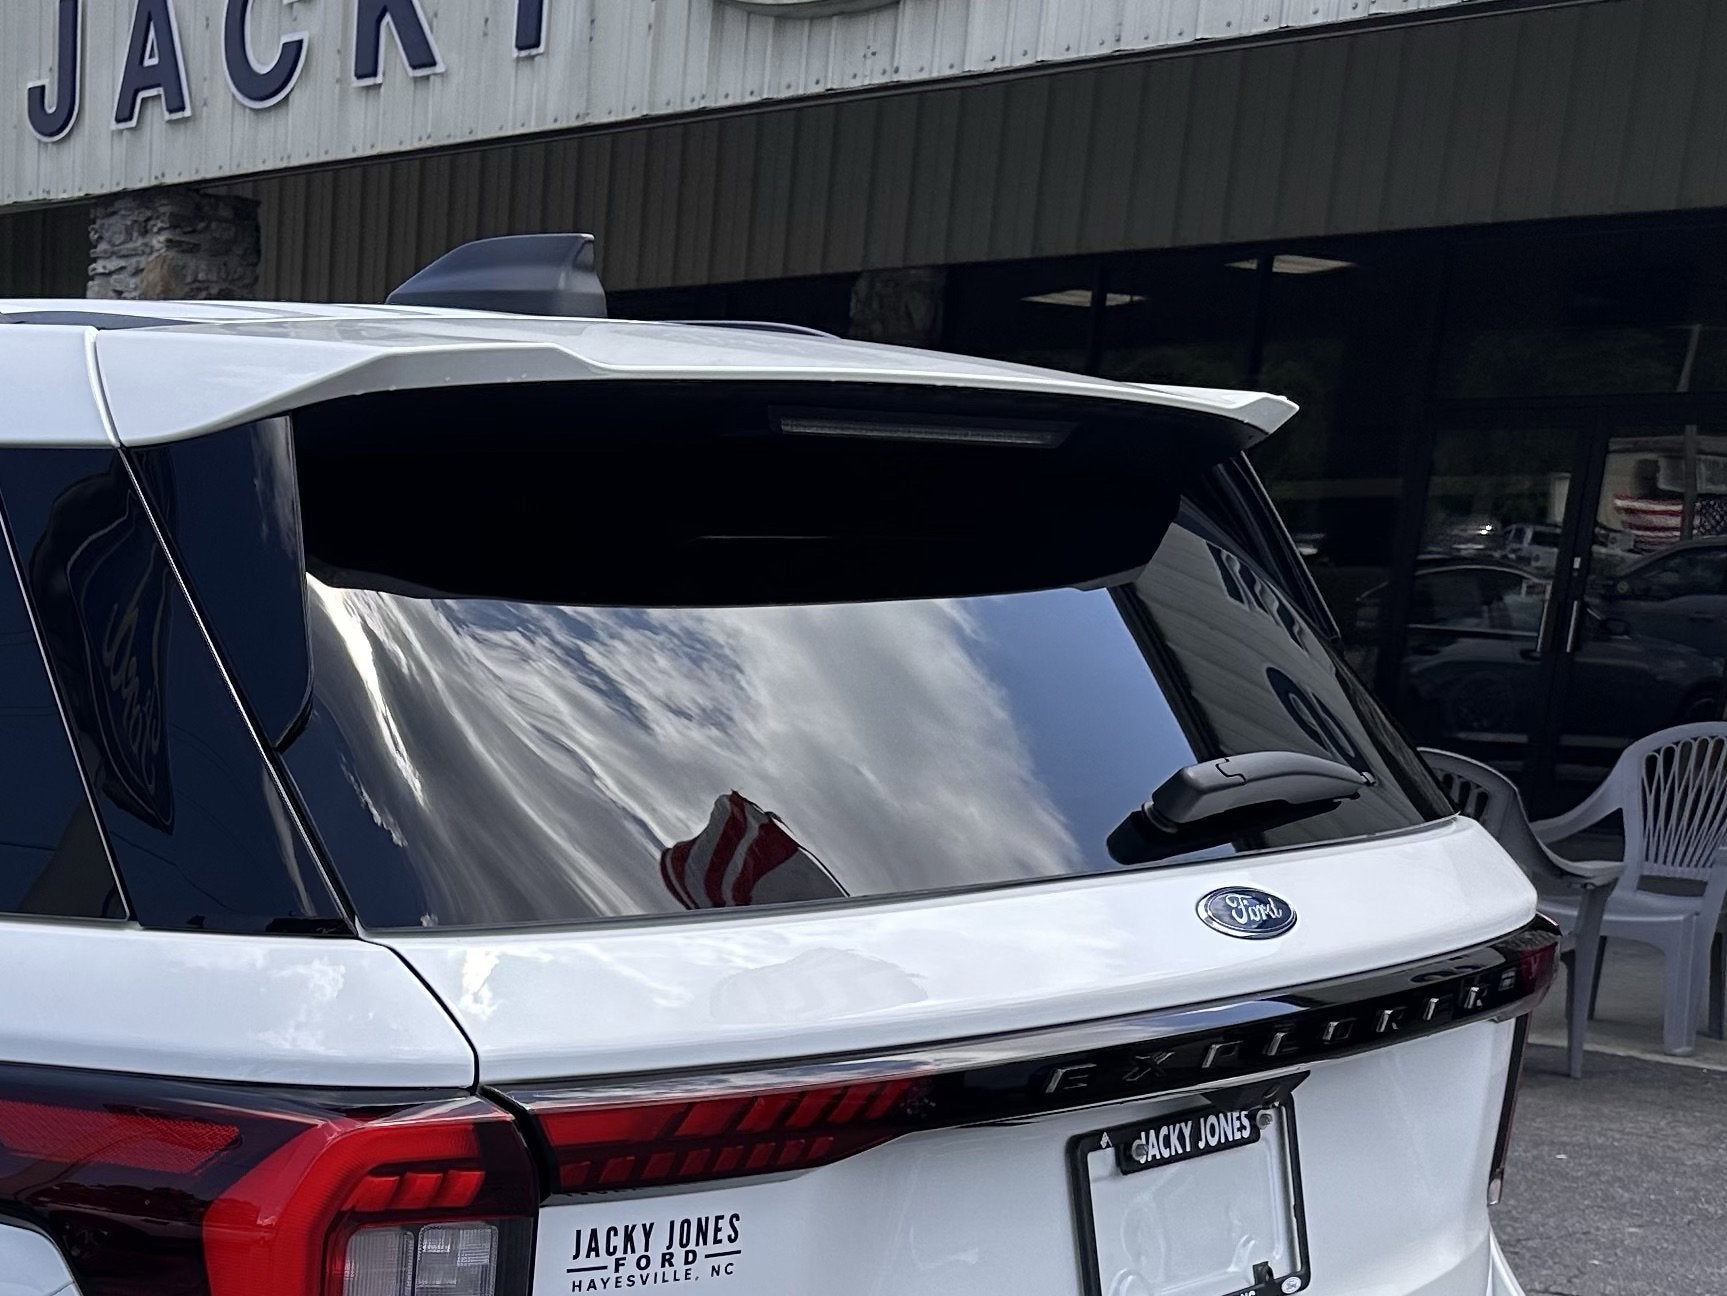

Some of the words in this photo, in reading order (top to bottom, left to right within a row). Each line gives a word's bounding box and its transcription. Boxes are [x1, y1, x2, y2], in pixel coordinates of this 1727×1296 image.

[1225, 892, 1283, 925] Ford
[1045, 985, 1491, 1094] EXPLORER
[1138, 1120, 1193, 1164] JACKY
[1198, 1109, 1251, 1150] JONES
[572, 1221, 655, 1260] JACKY
[666, 1212, 741, 1251] JONES
[571, 1267, 700, 1293] HAYESVILLE,
[710, 1262, 735, 1278] NC
[614, 1249, 698, 1274] FORD
